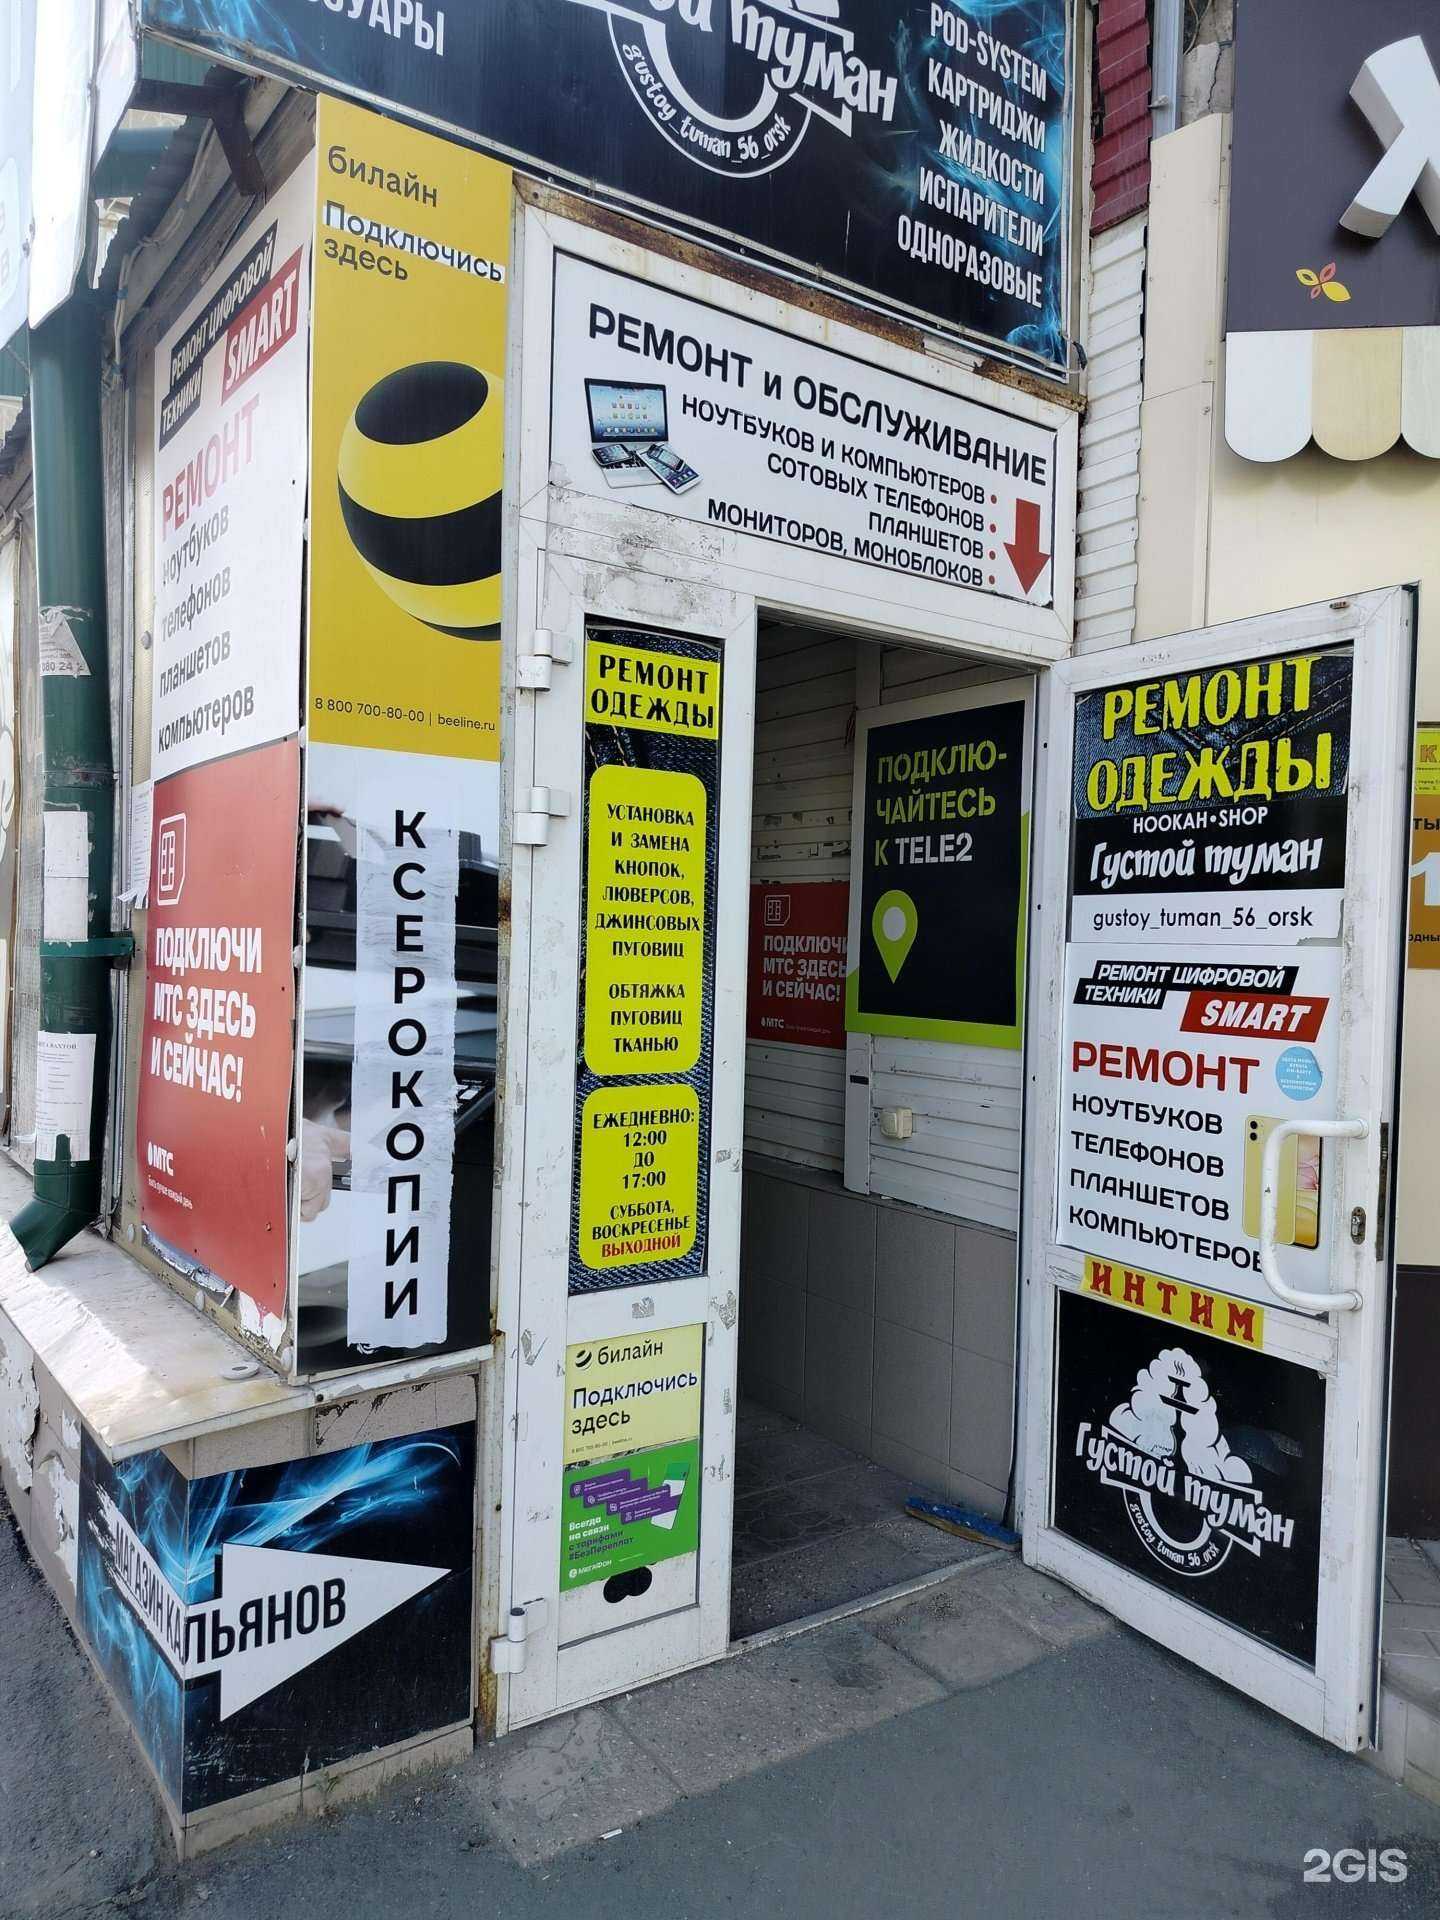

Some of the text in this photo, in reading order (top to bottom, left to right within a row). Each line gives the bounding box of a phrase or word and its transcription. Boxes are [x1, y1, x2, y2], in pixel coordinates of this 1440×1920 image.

[930, 2, 1047, 102] POD-SYSTEM
[928, 57, 1046, 153] КАРТРИДЖИ
[327, 145, 438, 208] билайн
[938, 119, 1045, 205] ЖИДКОСТИ
[919, 166, 1044, 257] ИСПАРИТЕЛИ
[324, 239, 409, 281] здесь
[325, 199, 503, 282] Подключись
[897, 214, 1043, 308] ОДНОРАЗОВЫЕ
[171, 233, 274, 386] РЕМОНТ ЦИФРОВОЙ
[225, 268, 298, 391] SMART
[162, 365, 204, 435] ТЕХНИКИ
[588, 302, 753, 388] РЕМОНТ
[793, 375, 1048, 487] ОБСЛУЖИВАНИЕ
[162, 393, 260, 542] РЕМОНТ
[682, 393, 986, 505] НОУТБУКОВ И КОМПЬЮТЕРОВ
[767, 452, 985, 533] СОТОВЫХ ТЕЛЕФОНОВ
[707, 498, 984, 587] МОНИТОРОВ, МОНОБЛОКОВ
[869, 511, 984, 560] ПЛАНШЕТОВ
[599, 654, 710, 694] РЕМОНТ
[315, 697, 496, 731] 8 800 700-80-00 beeline.ru
[591, 688, 714, 729] ОДЕЖДЫ
[1102, 655, 1323, 740] РЕМОНТ
[877, 739, 1008, 785] ПОДКЛЮ-
[1086, 732, 1332, 813] ОДЕЖДЫ
[607, 803, 695, 826] УСТАНОВКА
[876, 786, 997, 825] ЧАЙТЕСЬ
[611, 832, 690, 852] И ЗАМЕНА
[874, 832, 973, 867] К TELE2
[1090, 837, 1324, 889] Густой туман
[614, 859, 685, 879] КНОПОК,
[602, 886, 695, 907] ЛЮВЕРСОВ,
[595, 913, 701, 932] ДЖИНСОВЫХ
[1092, 905, 1313, 931] gustoy_tuman_56_orsk
[155, 926, 262, 978] ПОДКЛЮЧИ
[612, 941, 685, 958] ПУГОВИЦ
[763, 957, 795, 976] МТС
[609, 983, 685, 999] ОБТЯЖКА
[762, 976, 841, 1003] И СЕЙЧАС!
[1084, 985, 1162, 1006] ТЕХНИКИ
[1097, 964, 1286, 989] РЕМОНТ ЦИФРОВОЙ
[153, 982, 256, 1041] МТС ЗДЕСЬ
[610, 1010, 683, 1026] ПУГОВИЦ
[1200, 999, 1313, 1033] SMART
[384, 808, 429, 1321] КСЕРОКОПИИ
[613, 1036, 679, 1053] ТКАНЬЮ
[150, 1032, 244, 1104] И СЕЙЧАС!
[1072, 1041, 1260, 1094] РЕМОНТ
[593, 1108, 695, 1129] ЕЖЕДНЕВНО:
[1072, 1093, 1223, 1135] НОУТБУКОВ
[153, 1144, 174, 1176] МТС
[624, 1130, 667, 1148] 12:00
[633, 1151, 655, 1169] ДО
[1070, 1130, 1224, 1178] ТЕЛЕФОНОВ
[622, 1171, 667, 1190] 17:00
[1070, 1168, 1230, 1221] ПЛАНШЕТОВ
[592, 1215, 691, 1241] ВОСКРЕСЕНЬЕ
[610, 1199, 675, 1220] СУББОТА,
[601, 1233, 681, 1259] ВЫХОДНОЙ
[1089, 1260, 1256, 1343] ИНТИМ
[597, 1339, 663, 1365] билайн
[573, 1372, 698, 1409] Подключись
[571, 1410, 631, 1436] здесь
[1075, 1421, 1295, 1549] Густой туман
[115, 1520, 347, 1666] МАГАЗИН КАЛЬЯНОВ
